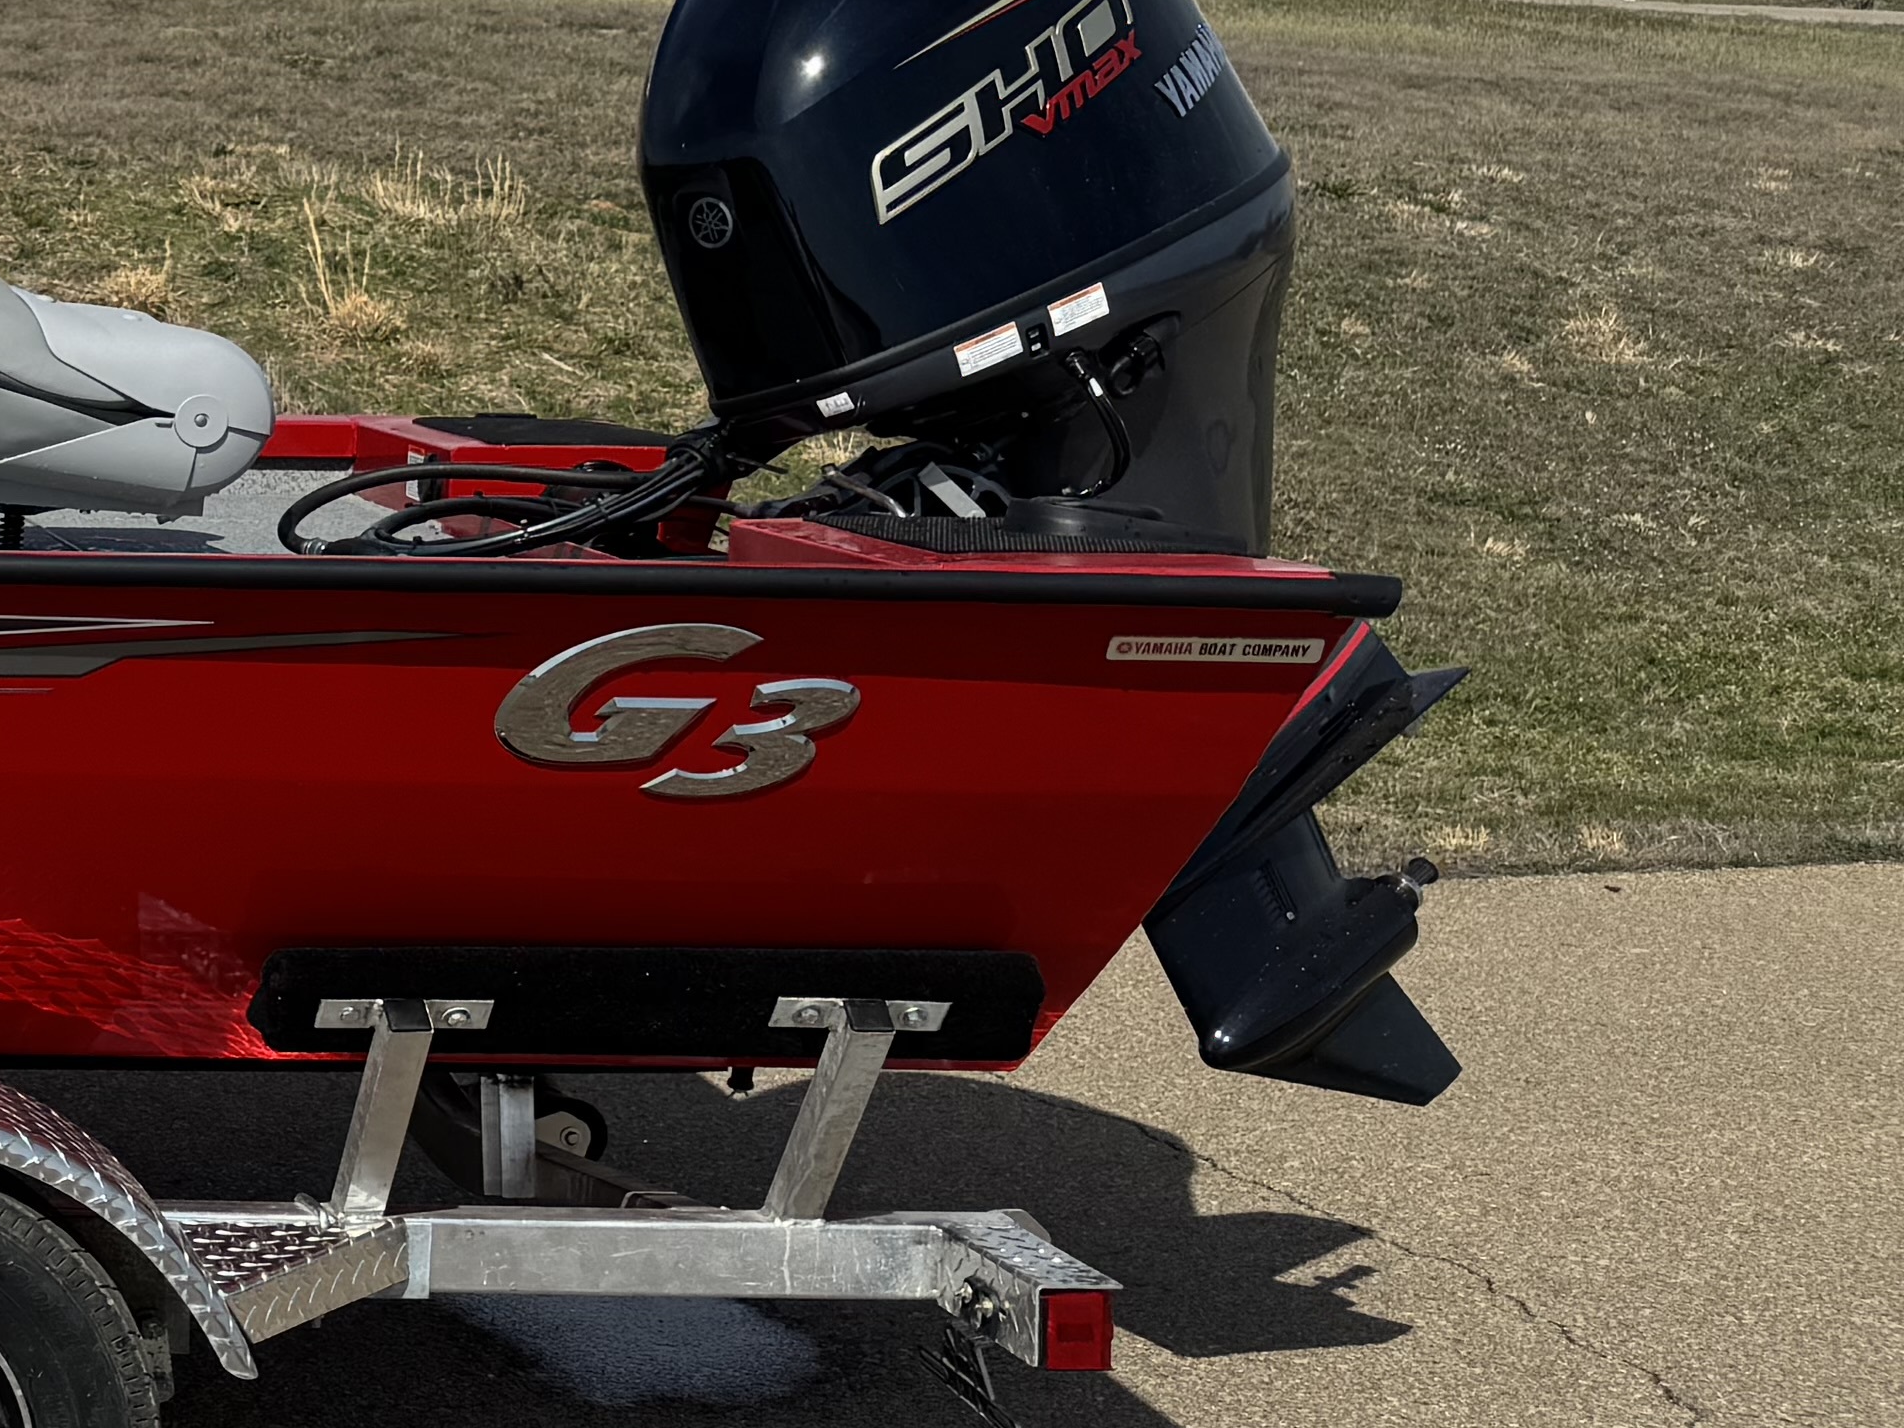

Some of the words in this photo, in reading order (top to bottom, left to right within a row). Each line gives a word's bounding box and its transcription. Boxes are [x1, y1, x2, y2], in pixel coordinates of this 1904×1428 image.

[1134, 641, 1193, 655] YAMAHA
[1198, 642, 1237, 656] BOAT
[1242, 643, 1312, 658] COMPANY
[494, 622, 861, 797] G3
